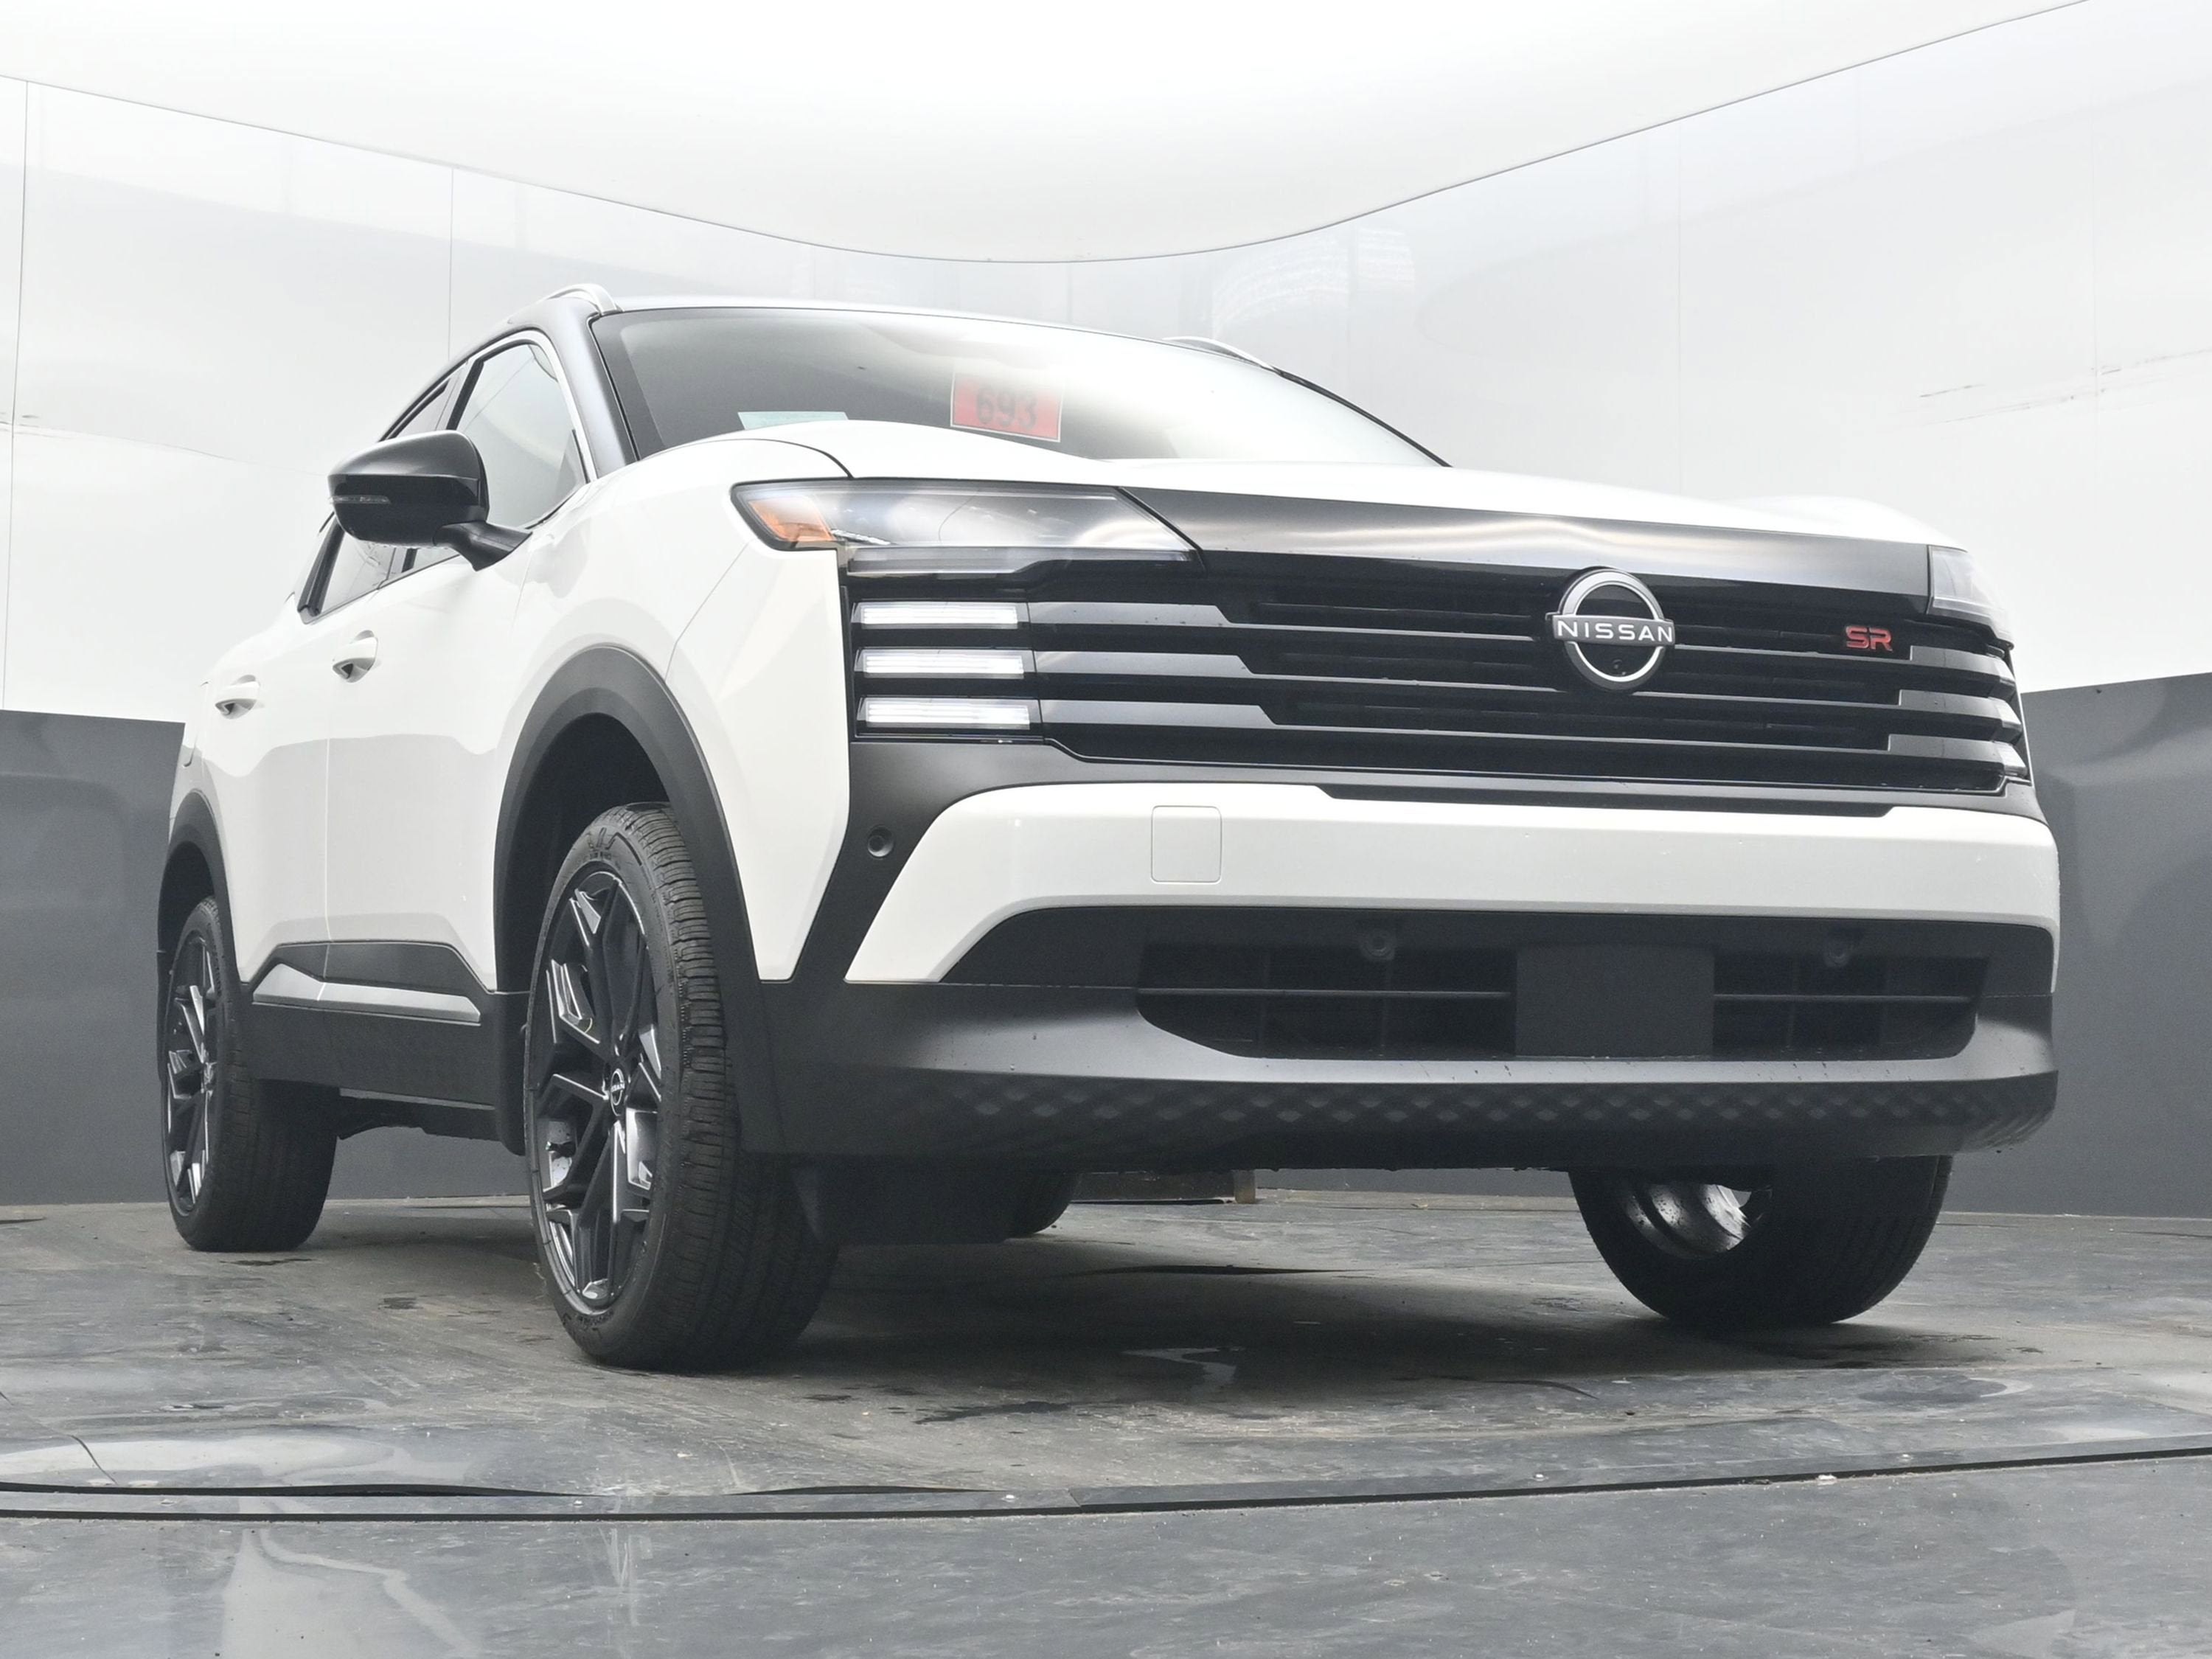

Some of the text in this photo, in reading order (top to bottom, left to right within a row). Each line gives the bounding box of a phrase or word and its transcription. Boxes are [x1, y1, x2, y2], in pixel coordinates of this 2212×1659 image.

[975, 386, 1037, 429] 693
[1557, 620, 1673, 643] NISSAN
[1846, 625, 1893, 652] SR
